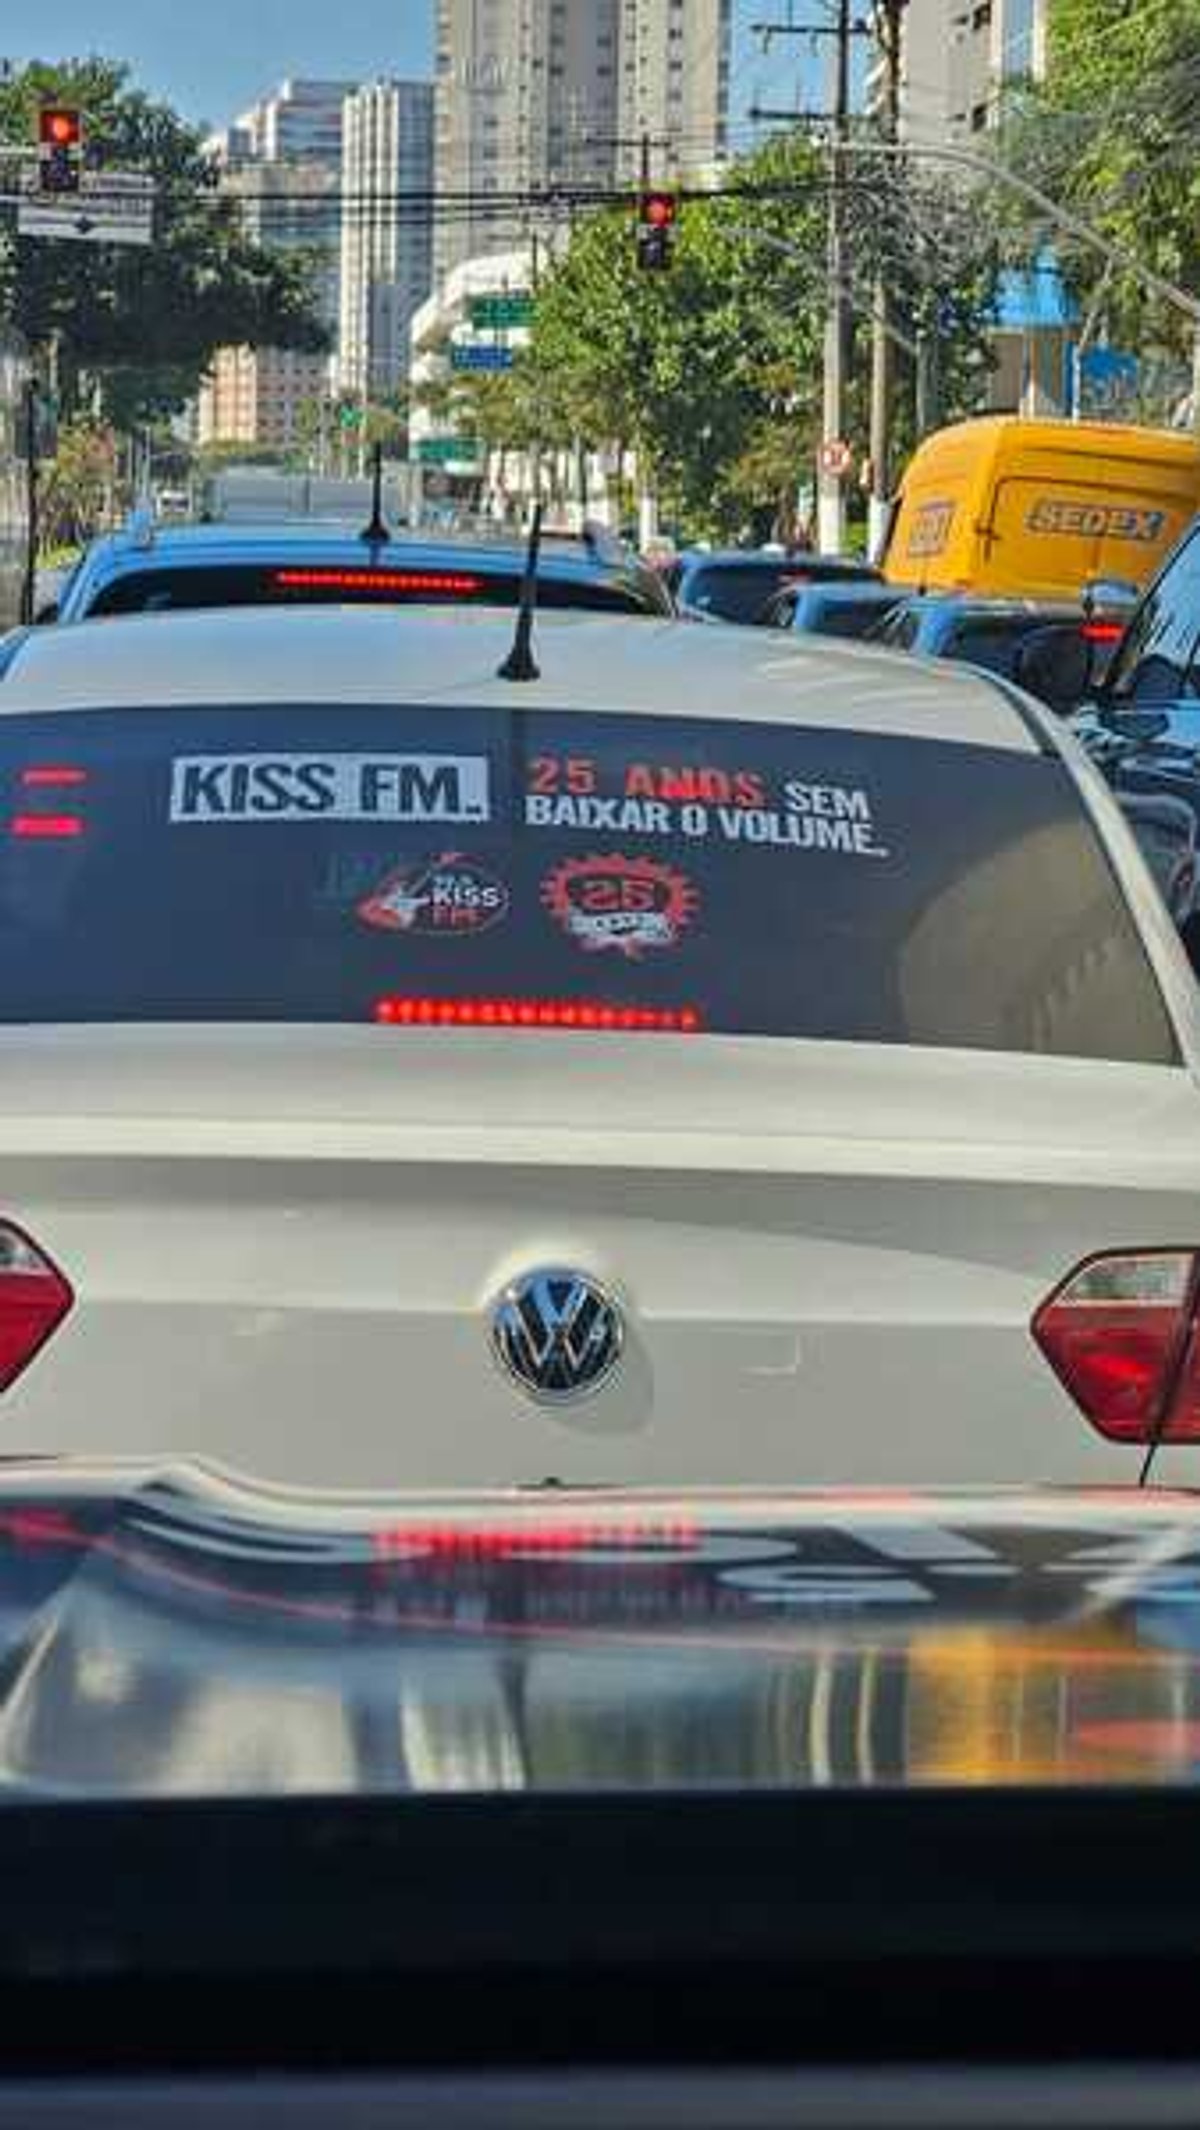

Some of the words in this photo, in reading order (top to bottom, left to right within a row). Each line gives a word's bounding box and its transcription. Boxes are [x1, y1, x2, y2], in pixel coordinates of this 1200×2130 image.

[181, 763, 336, 814] KISS
[359, 764, 482, 814] FM.
[529, 758, 596, 794] 25
[784, 781, 870, 821] SEM
[525, 795, 672, 833] BAIXAR
[680, 805, 707, 836] O
[431, 887, 500, 907] KISS
